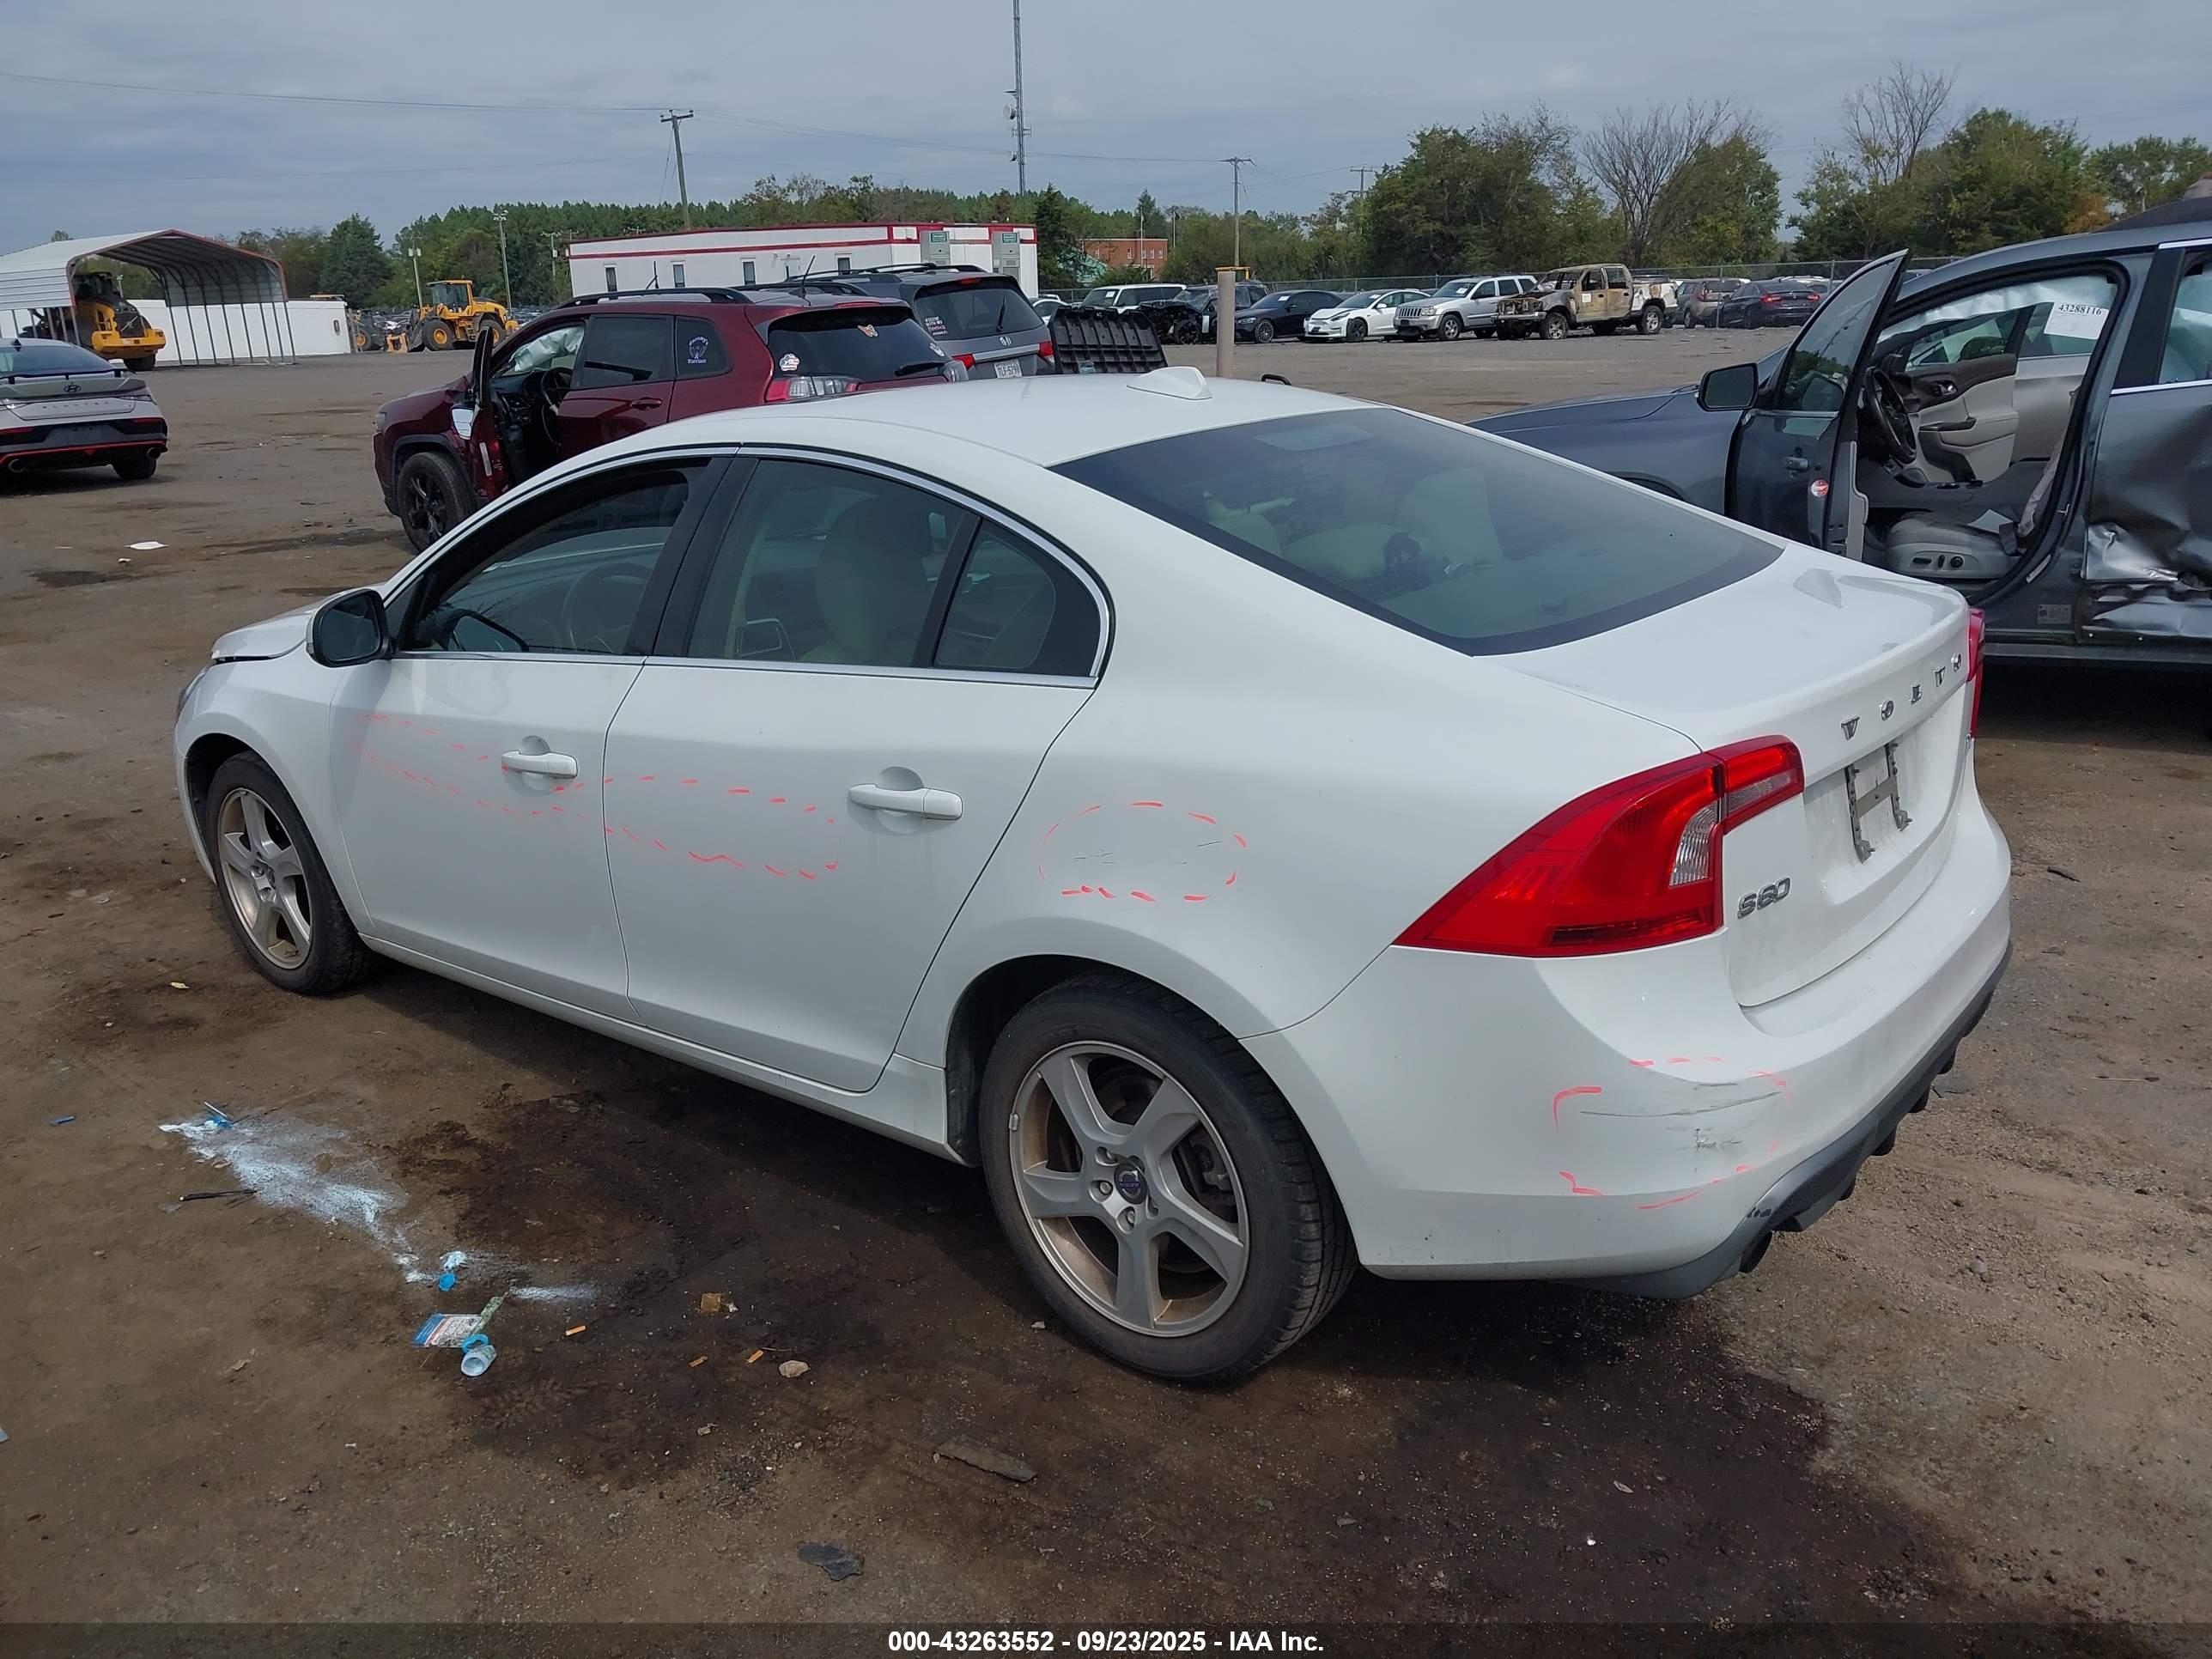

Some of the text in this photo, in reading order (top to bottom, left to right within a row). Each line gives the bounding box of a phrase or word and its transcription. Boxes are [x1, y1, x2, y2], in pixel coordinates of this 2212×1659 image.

[2058, 304, 2102, 315] 43288116
[1841, 653, 1962, 740] VOLVO
[1736, 878, 1791, 920] S60
